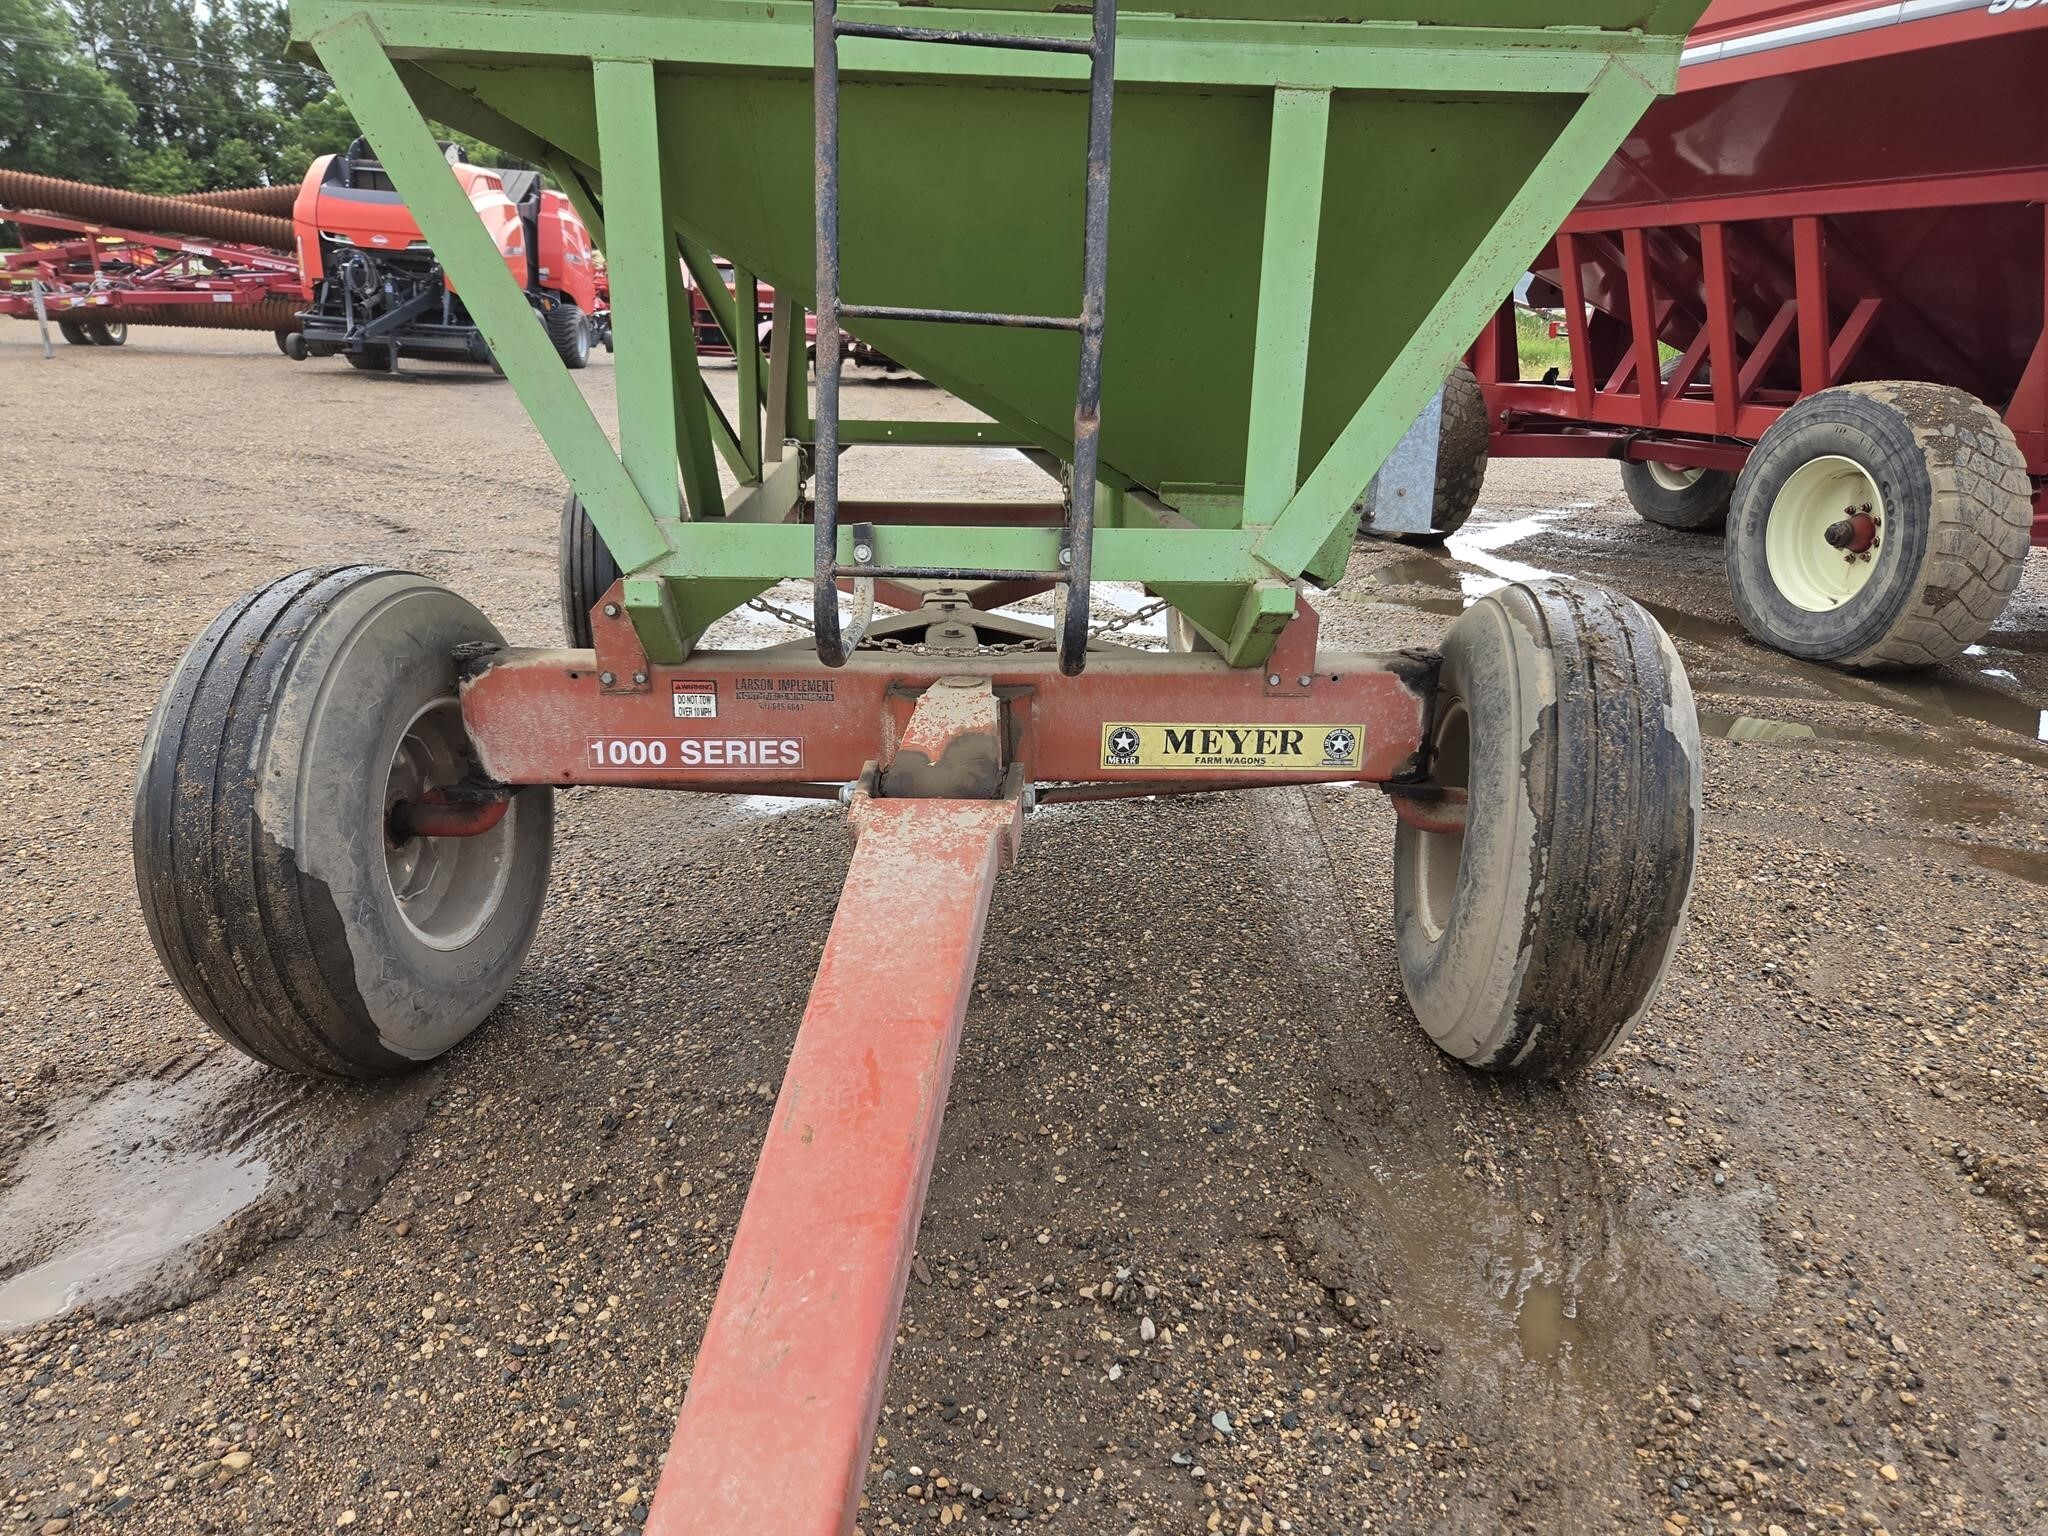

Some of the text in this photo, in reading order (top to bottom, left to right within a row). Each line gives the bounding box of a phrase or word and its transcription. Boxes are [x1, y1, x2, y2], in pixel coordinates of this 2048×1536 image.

[736, 678, 773, 690] LARSON
[778, 680, 834, 692] IMPLEMENT
[678, 695, 712, 705] DO NOT TOW
[678, 707, 712, 717] OVER 10 MPH
[1162, 729, 1304, 755] MEYER
[591, 740, 800, 765] 1000 SERIES
[1108, 756, 1137, 764] MEYER
[1195, 757, 1266, 765] FARM WAGONS
